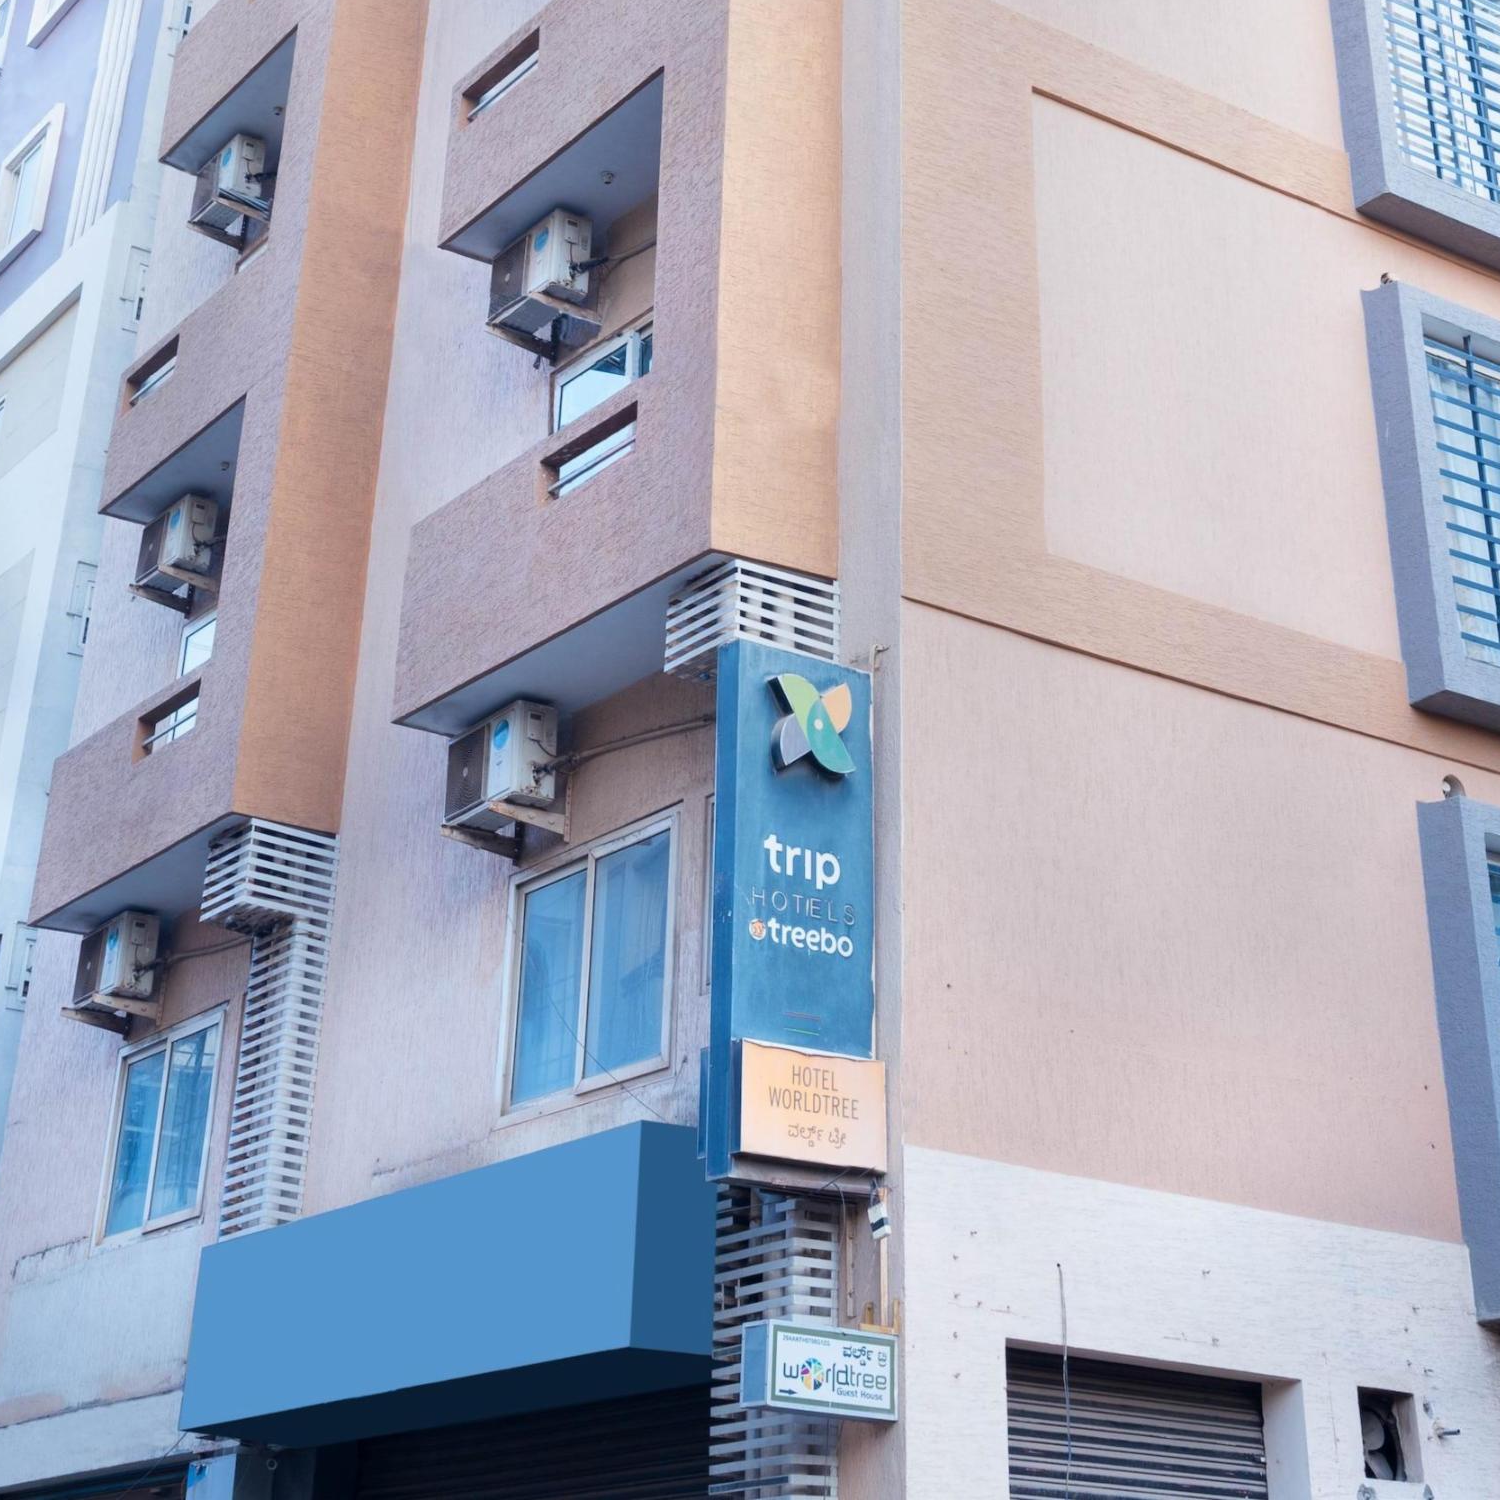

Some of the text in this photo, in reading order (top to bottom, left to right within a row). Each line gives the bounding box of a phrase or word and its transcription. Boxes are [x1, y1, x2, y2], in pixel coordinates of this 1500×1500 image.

[763, 833, 841, 890] trip
[751, 886, 856, 926] HOTELS
[767, 916, 854, 958] treebo
[792, 1064, 839, 1093] HOTEL
[768, 1085, 860, 1121] WORLDTREE
[782, 1356, 888, 1393] worldtree
[836, 1386, 884, 1401] Guest House
